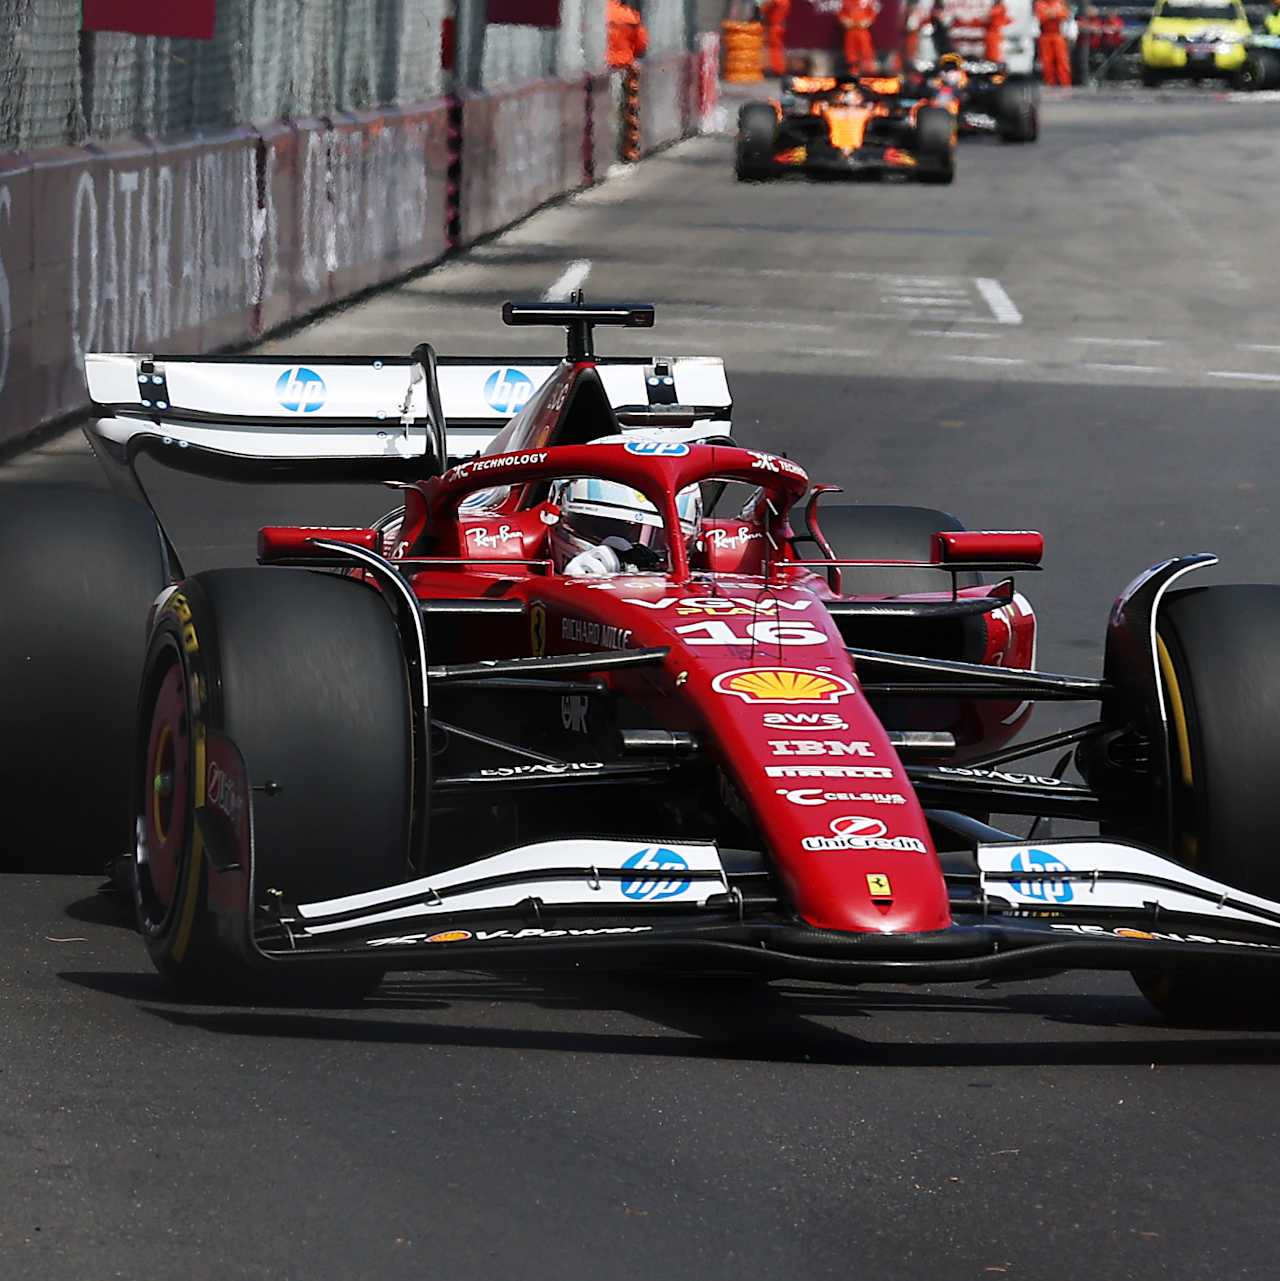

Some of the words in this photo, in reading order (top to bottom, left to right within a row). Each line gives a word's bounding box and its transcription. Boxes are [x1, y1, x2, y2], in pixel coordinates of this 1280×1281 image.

[278, 367, 325, 413] hp
[472, 453, 548, 472] TECHNOLOGY
[465, 524, 524, 548] Ray-Ban
[706, 526, 764, 549] Ray-Ban
[622, 597, 813, 610] VGW
[676, 607, 780, 616] PLAY
[562, 617, 601, 645] RICHARD
[601, 625, 632, 651] MILLE
[674, 620, 829, 646] 16
[763, 712, 843, 725] aws
[768, 740, 875, 757] IBM
[764, 766, 893, 779] PIRELLI
[805, 837, 923, 851] UniCredit
[625, 847, 691, 901] hp
[1011, 849, 1074, 904] hp
[475, 926, 653, 941] V-Power
